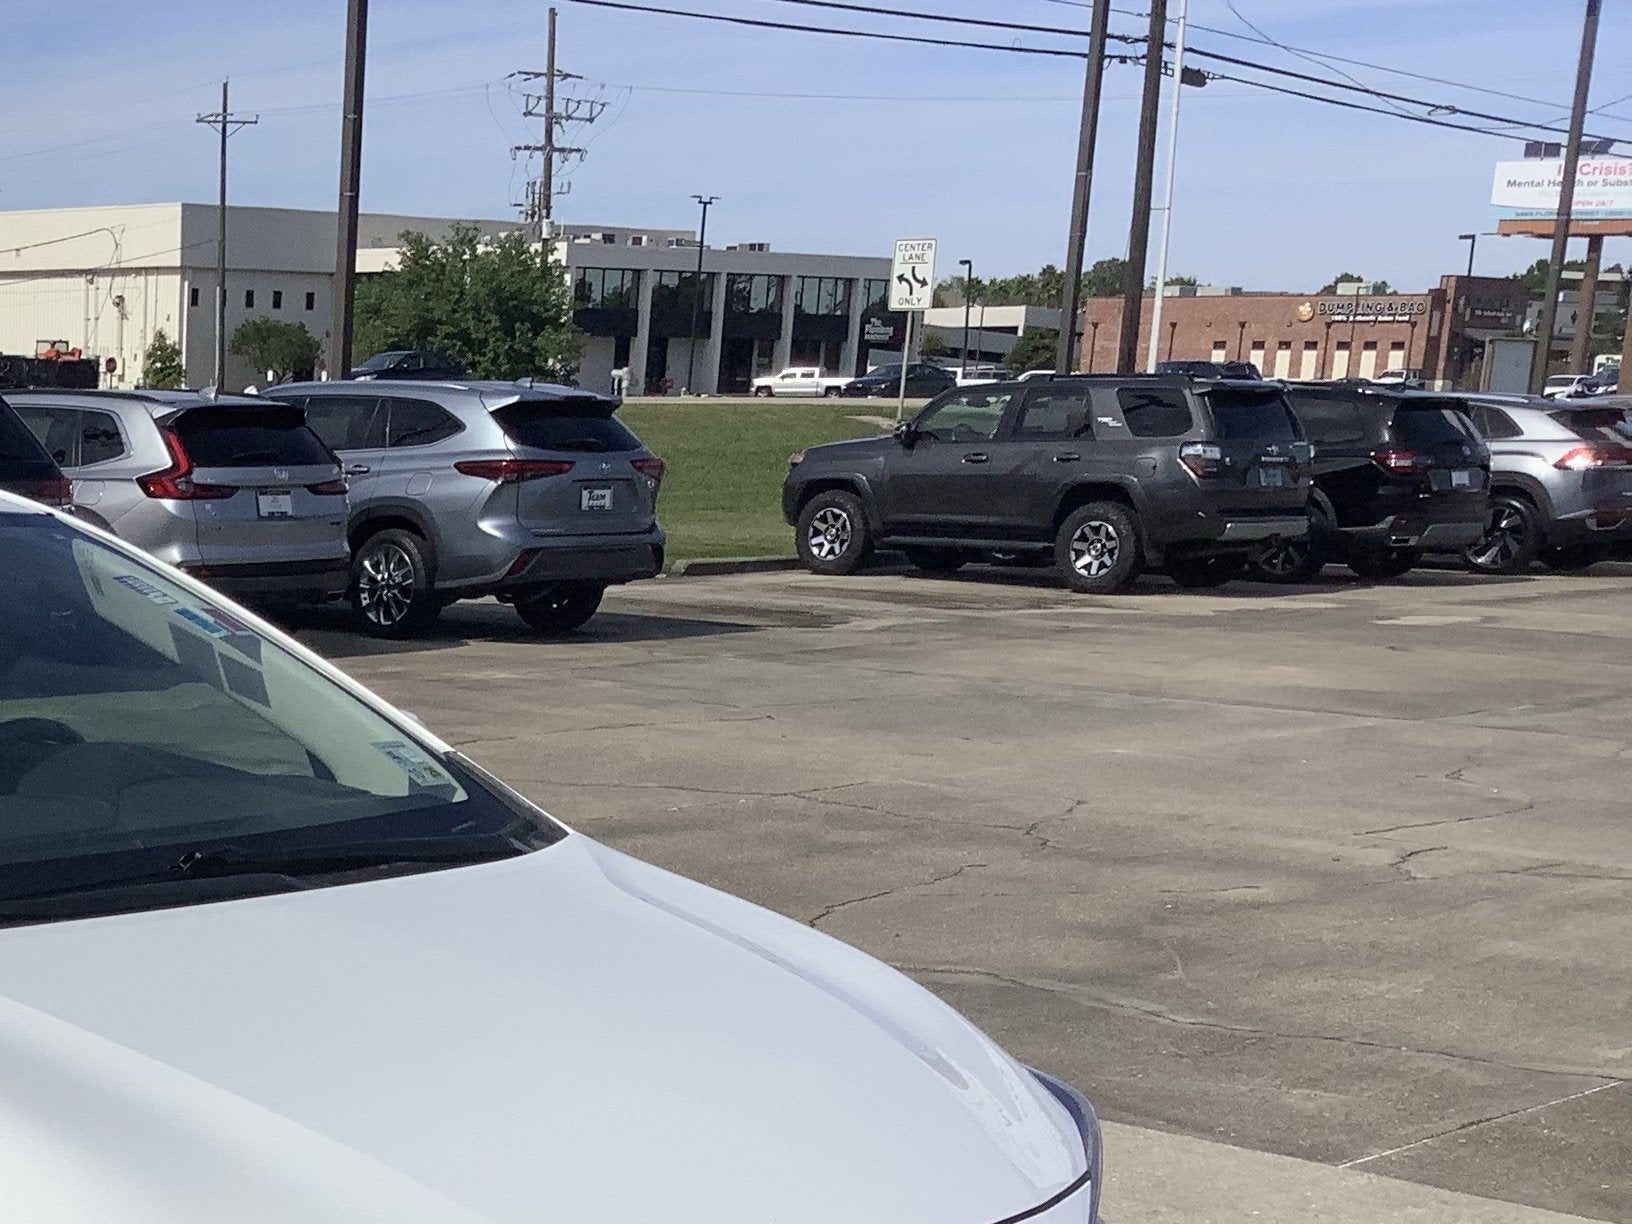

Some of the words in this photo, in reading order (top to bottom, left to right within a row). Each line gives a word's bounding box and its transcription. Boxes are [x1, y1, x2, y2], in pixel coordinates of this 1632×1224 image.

[1506, 179, 1544, 188] Mental
[898, 242, 933, 252] CENTER
[902, 253, 927, 262] LANE
[897, 297, 923, 306] ONLY
[1318, 301, 1385, 314] DUMPING
[1387, 302, 1395, 313] &
[1398, 301, 1426, 314] BAO
